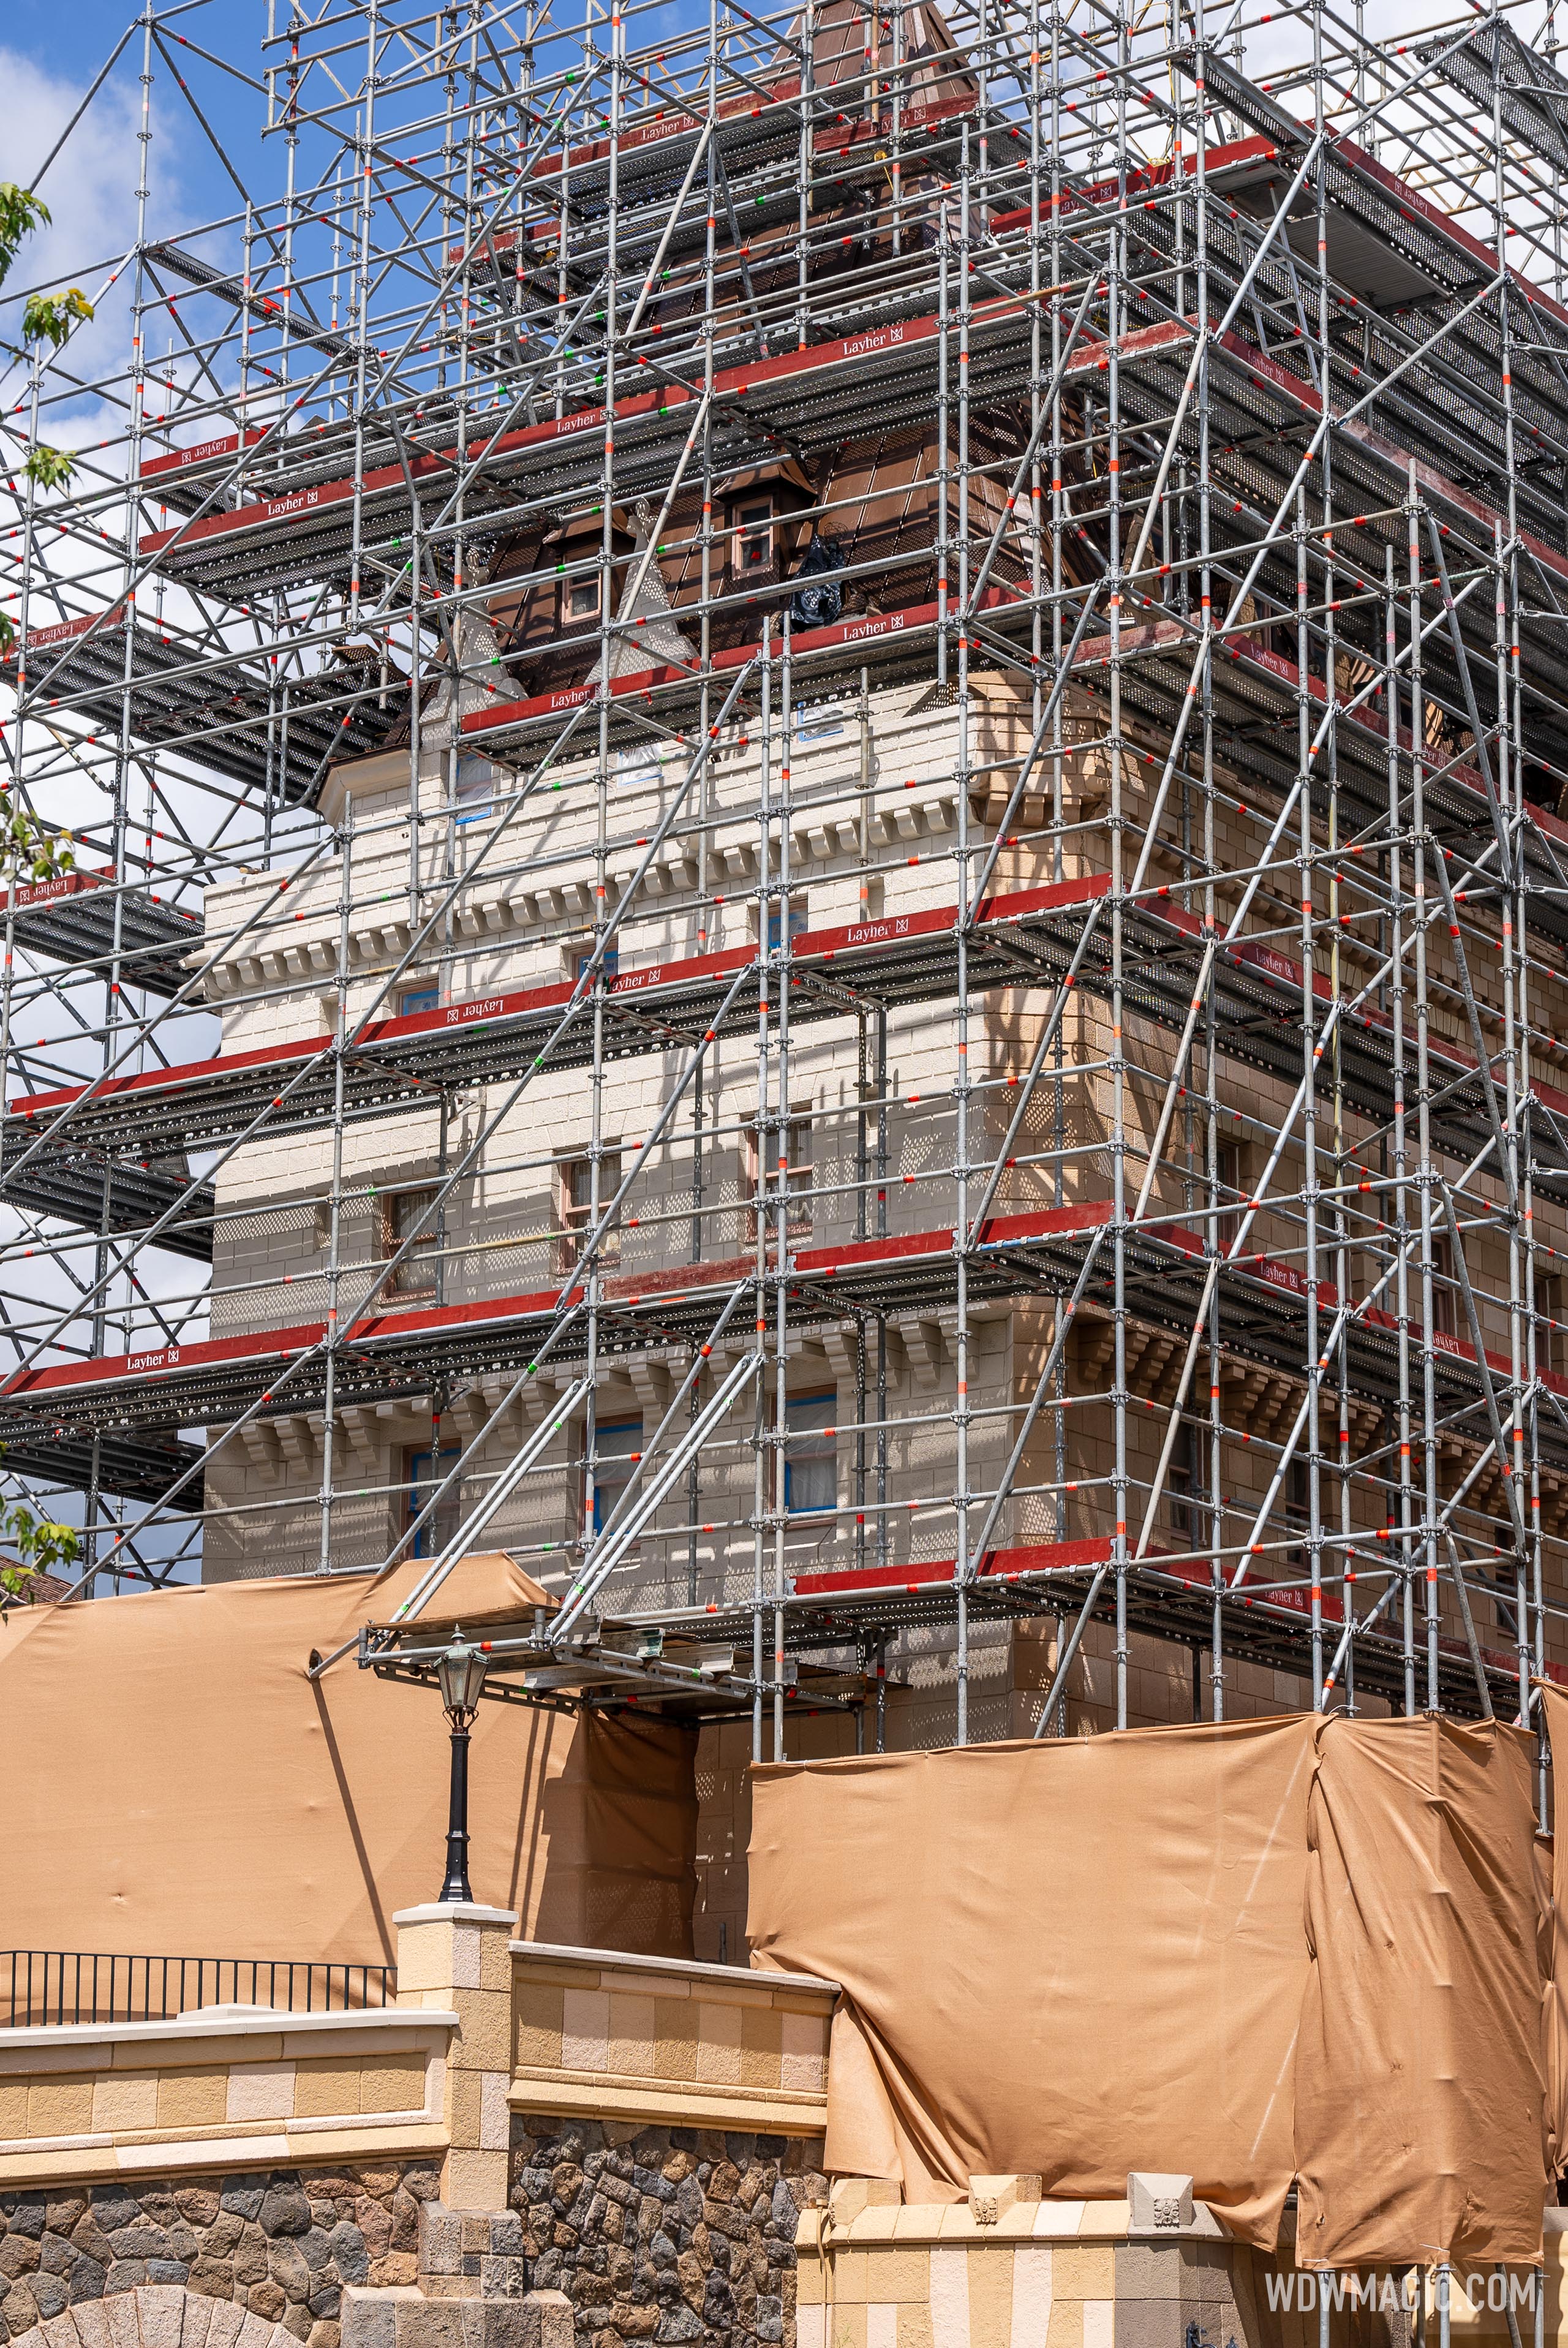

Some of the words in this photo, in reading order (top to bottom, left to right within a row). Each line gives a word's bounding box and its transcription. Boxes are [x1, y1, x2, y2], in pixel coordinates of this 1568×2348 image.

[642, 121, 679, 140] Layher
[870, 114, 910, 133] Layr
[1060, 193, 1096, 212] ayer
[1404, 188, 1428, 215] Layher
[843, 334, 886, 355] Layher
[1248, 350, 1273, 375] Layher
[557, 414, 595, 433] Layher
[195, 440, 227, 457] Layher
[268, 497, 304, 516] Layher
[40, 624, 74, 641] Layher
[843, 621, 886, 641] Layher
[1251, 643, 1278, 670] Layher
[551, 690, 590, 708] Layher
[34, 880, 67, 896] Layher
[847, 925, 891, 942] Layher
[1256, 948, 1283, 973] Layher
[609, 975, 645, 992] ayher
[463, 999, 504, 1017] Layher
[1261, 1262, 1287, 1283] Layher
[127, 1354, 164, 1370] Layher
